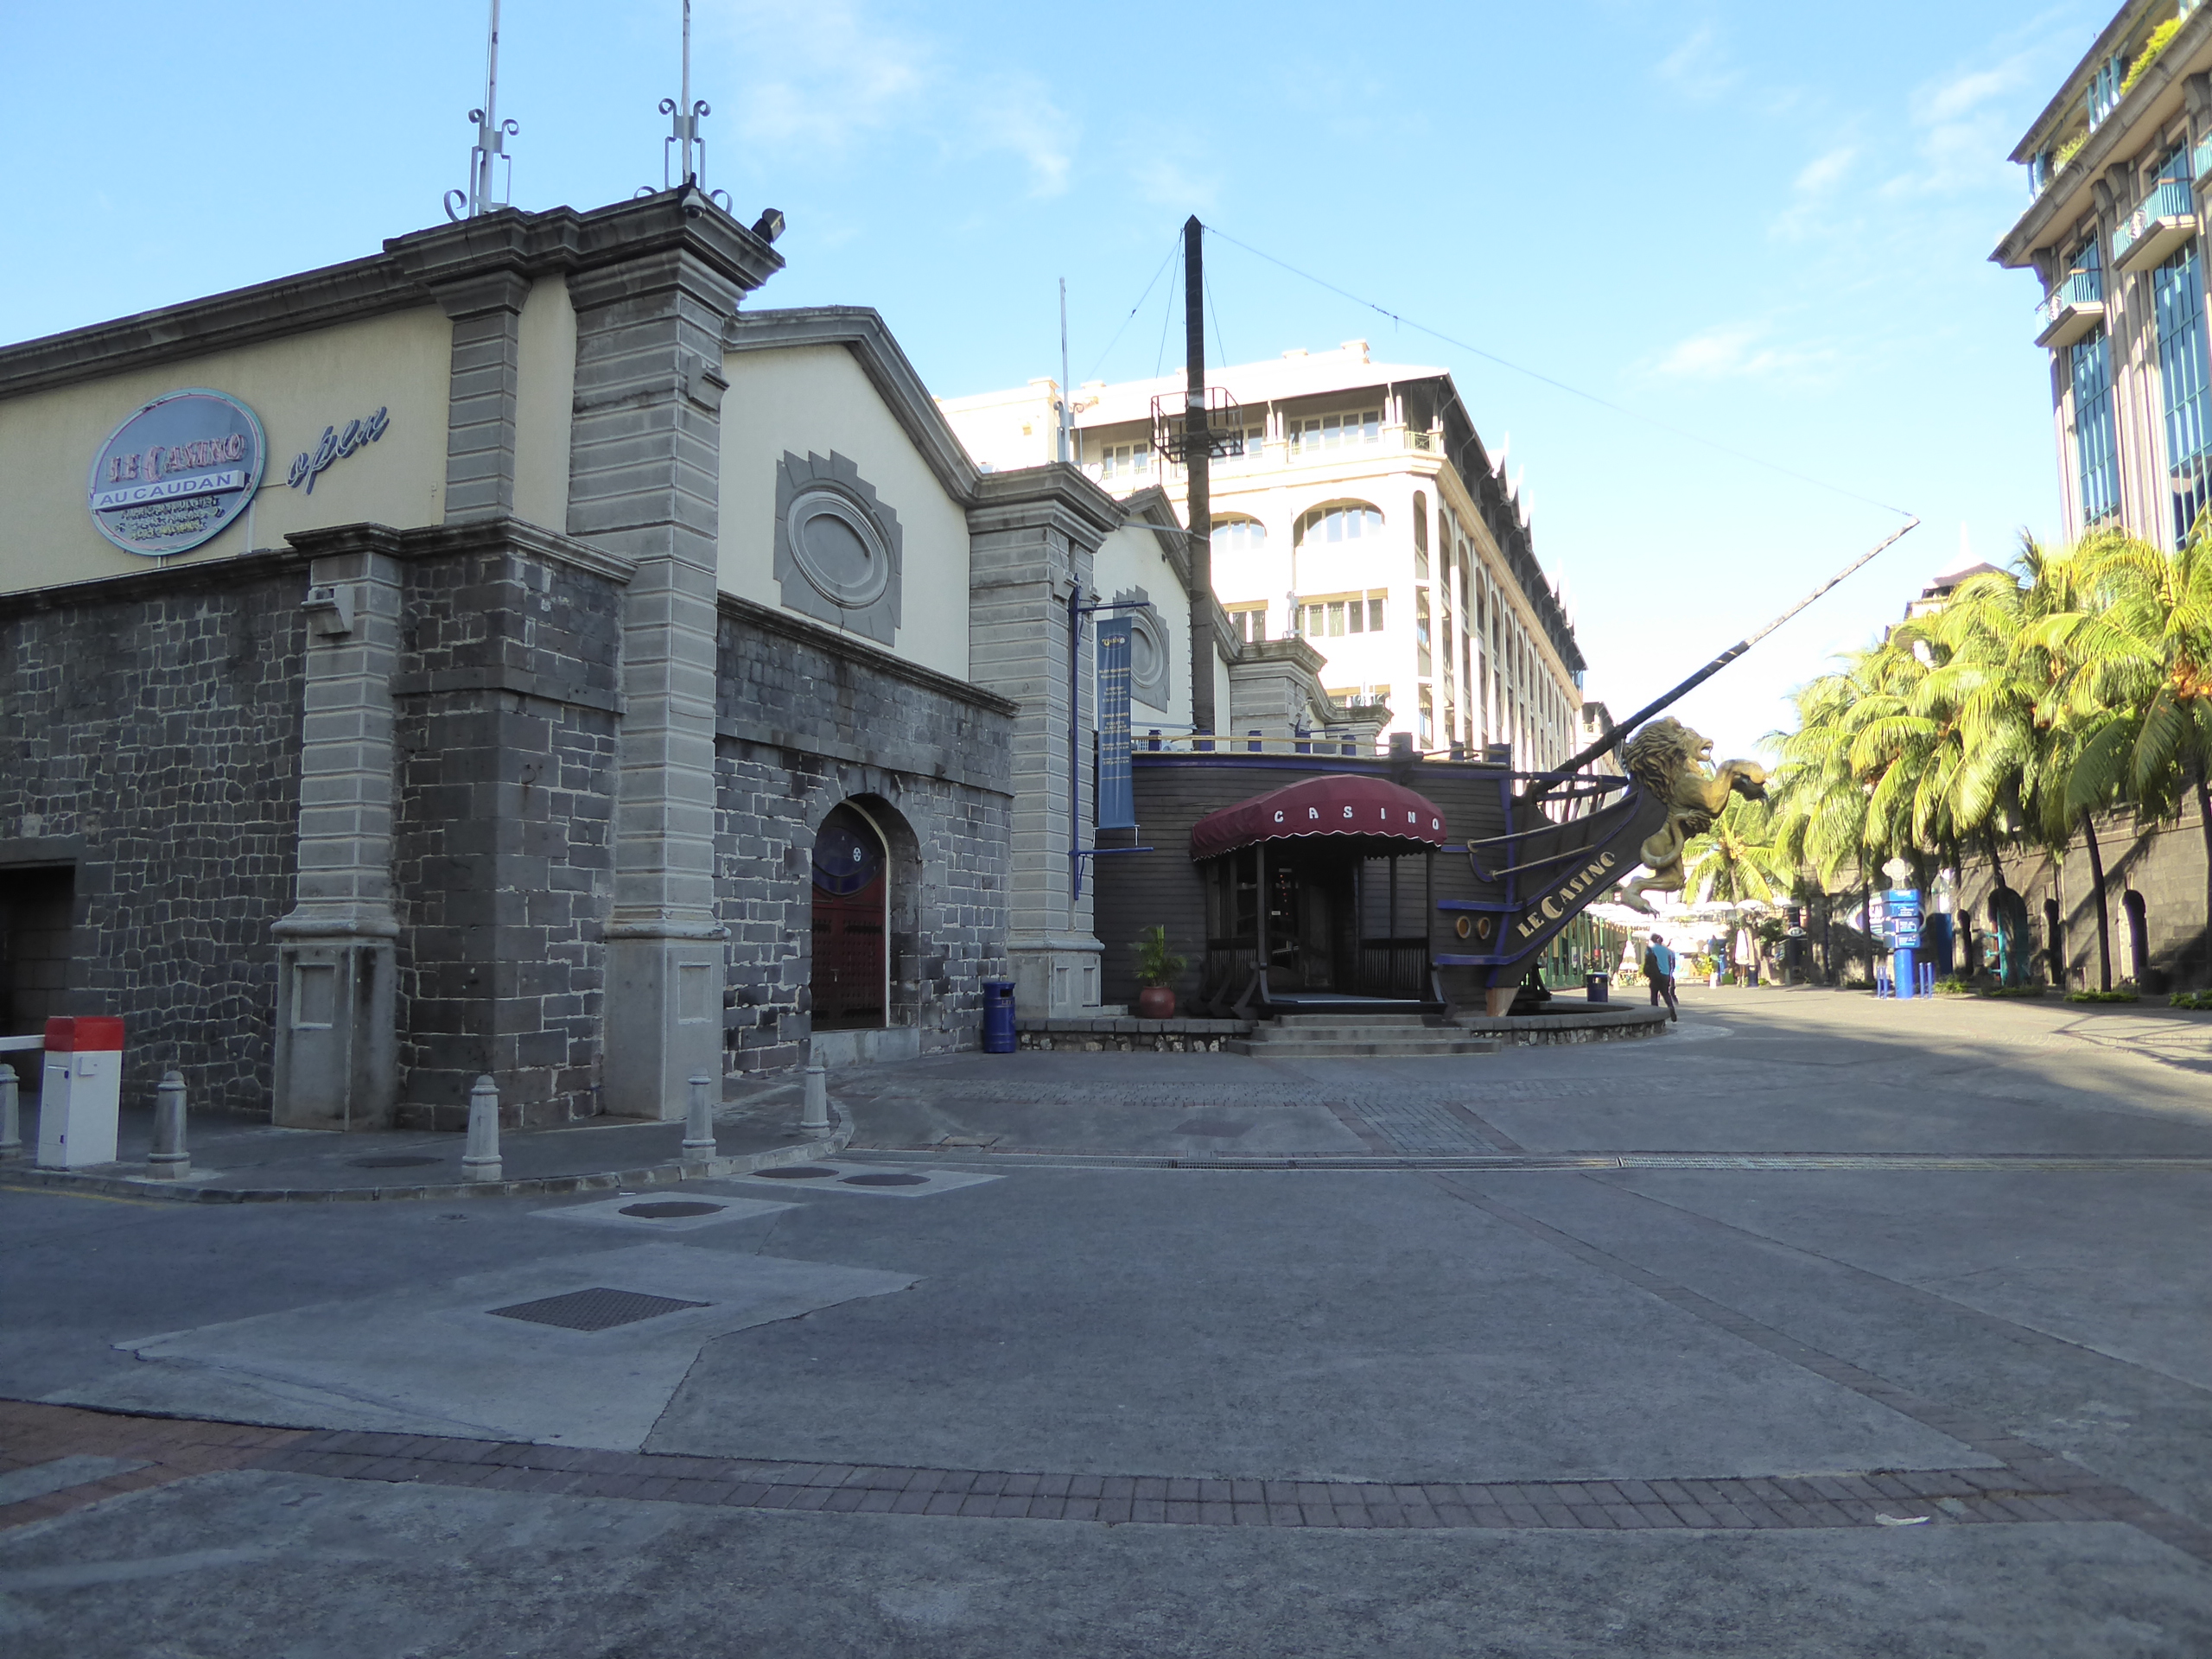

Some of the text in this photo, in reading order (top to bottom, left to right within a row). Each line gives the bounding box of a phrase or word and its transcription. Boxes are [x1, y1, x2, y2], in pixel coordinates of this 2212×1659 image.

[142, 433, 247, 483] CASINO
[286, 406, 389, 495] open
[99, 474, 232, 506] AU CAUDAN
[1274, 805, 1440, 830] CASINO
[1516, 851, 1616, 938] LE CASINO
